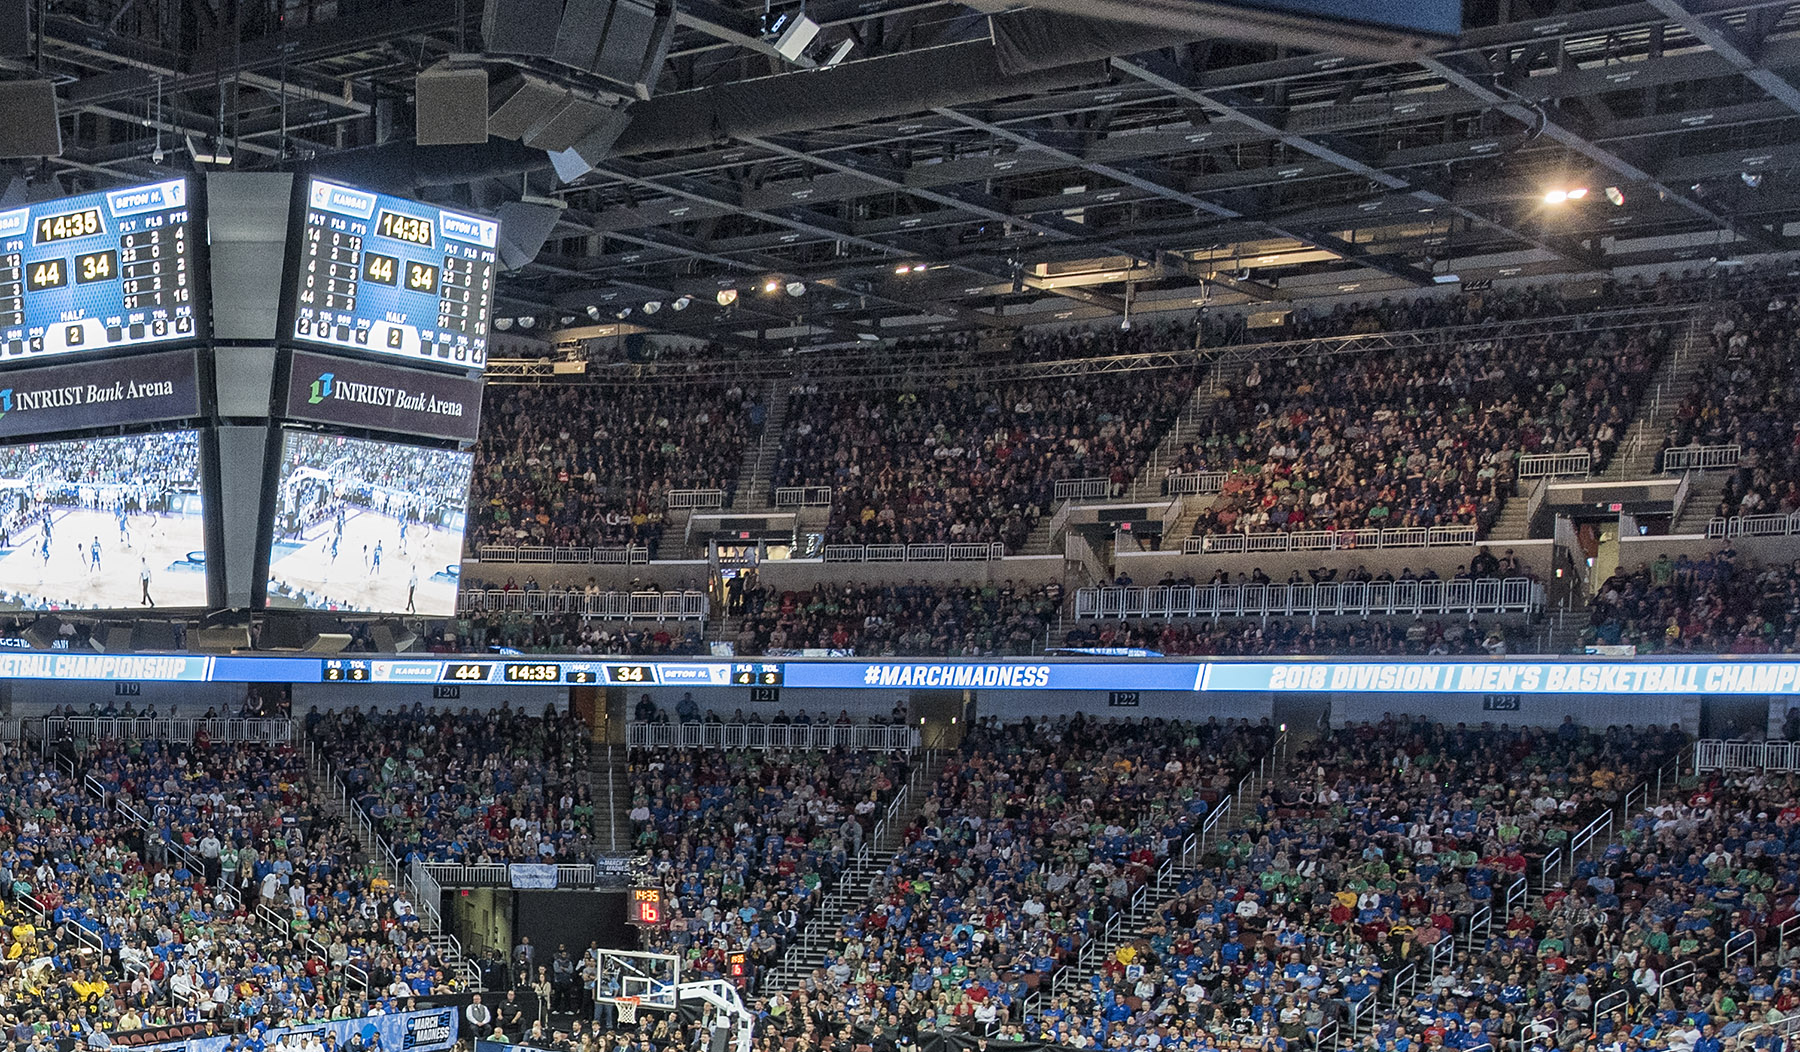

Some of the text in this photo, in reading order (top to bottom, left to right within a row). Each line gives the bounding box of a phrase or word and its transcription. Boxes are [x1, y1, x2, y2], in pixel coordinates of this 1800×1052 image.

[333, 193, 367, 210] KANSAS
[41, 211, 97, 241] 14:35
[120, 212, 188, 232] PLY FLS PTS
[309, 213, 367, 235] PLY FLS PTS
[384, 214, 430, 243] 14:35
[175, 226, 184, 239] 4
[308, 227, 361, 250] 14 12
[6, 240, 24, 251] PTS
[6, 254, 20, 267] 12
[122, 249, 137, 262] 22
[83, 254, 109, 279] 34
[308, 260, 316, 272] 4
[369, 257, 392, 282] 44
[34, 263, 60, 286] 44
[410, 265, 432, 290] 34
[442, 271, 455, 284] 22
[124, 281, 138, 294] 13
[124, 288, 188, 309] 31 16
[300, 289, 314, 303] 44
[60, 308, 85, 321] HALF
[440, 301, 451, 314] 13
[178, 317, 188, 331] 4
[385, 311, 407, 324] HALF
[155, 321, 164, 335] 3
[301, 319, 309, 333] 2
[320, 322, 328, 336] 3
[474, 321, 486, 335] 16
[70, 327, 79, 342] 2
[391, 330, 399, 345] 2
[457, 346, 464, 360] 3
[473, 348, 481, 362] 4
[16, 379, 174, 411] INTRUST Bank Arena
[334, 380, 463, 417] INTRUST Bank Arena
[54, 655, 186, 679] CHAMPIONSHIP
[394, 668, 432, 676] KANSAS
[455, 666, 481, 679] 44
[508, 666, 557, 680] 14:35
[617, 667, 643, 681] 34
[329, 670, 338, 680] 2
[353, 670, 363, 680] 3
[576, 673, 585, 682] 2
[739, 673, 749, 684] 4
[765, 673, 775, 684] 3
[864, 665, 1051, 687] #MARCHMADNESS
[1270, 667, 1327, 689] 2018
[1331, 666, 1441, 690] DIVISION
[1444, 667, 1455, 690] I
[1547, 667, 1699, 692] BASKETBALL
[118, 683, 139, 695] 119
[437, 687, 458, 698] 120
[754, 689, 776, 699] 121
[1113, 693, 1136, 705] 122
[1488, 695, 1516, 710] 123
[635, 889, 659, 901] 14:35
[642, 903, 657, 921] 16
[414, 1016, 439, 1030] MARCH
[416, 1026, 449, 1042] MADNESS
